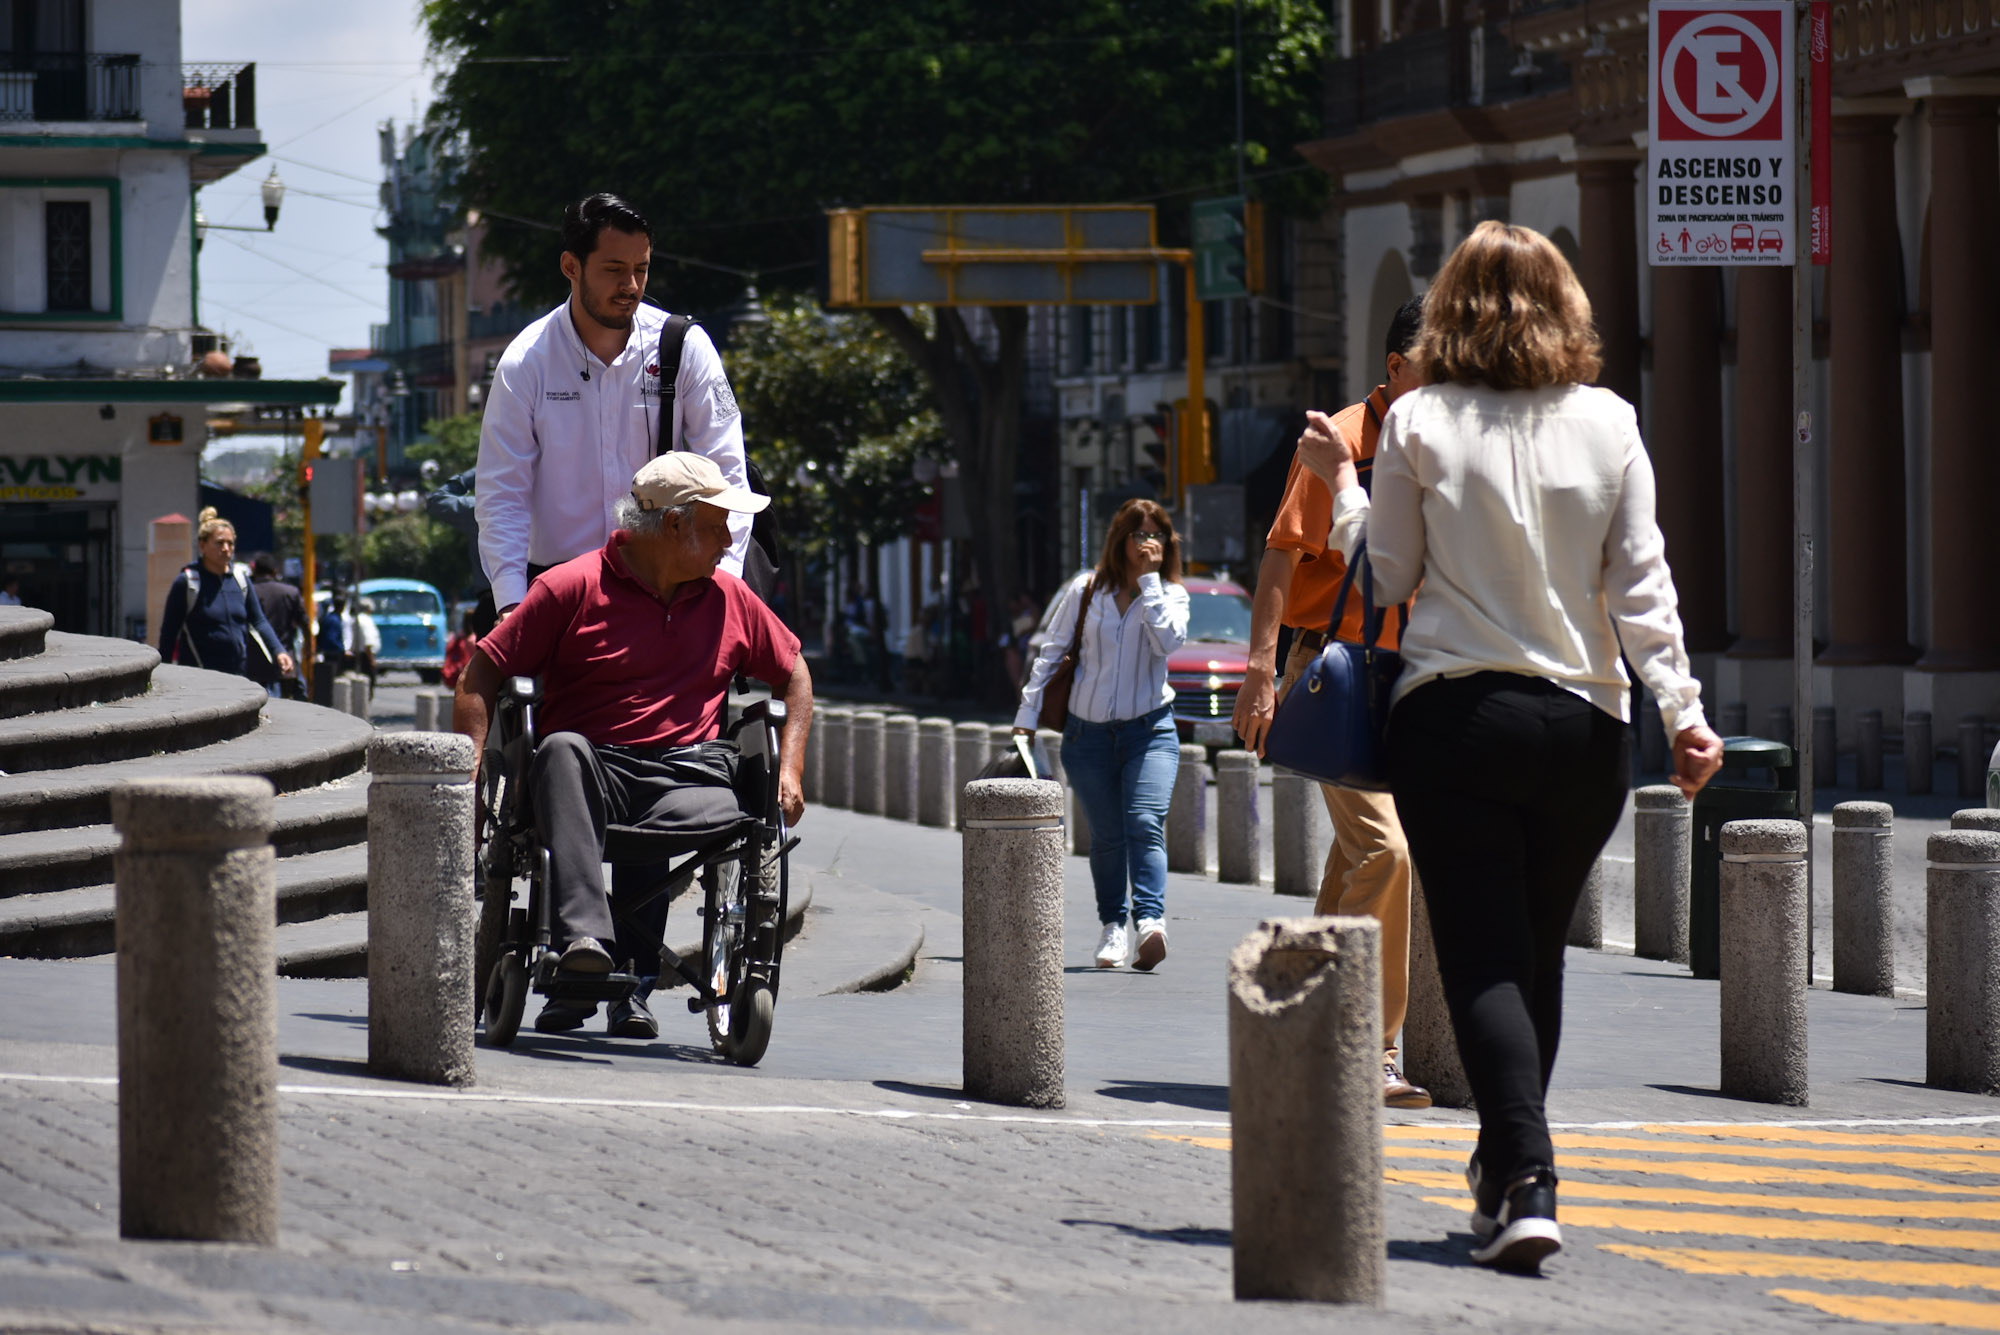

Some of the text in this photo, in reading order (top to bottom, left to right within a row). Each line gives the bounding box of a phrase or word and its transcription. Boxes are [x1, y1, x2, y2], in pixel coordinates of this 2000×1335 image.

[1658, 157, 1783, 179] ASCENSO Y
[1659, 184, 1783, 206] DESCENSO
[1657, 212, 1784, 222] ZONA DE PACIFICACIÓN DEL TRÁNSITO
[1811, 206, 1821, 254] XALAPA
[1677, 255, 1698, 263] respeto
[0, 456, 121, 484] VLYN
[0, 486, 78, 499] PTICOS
